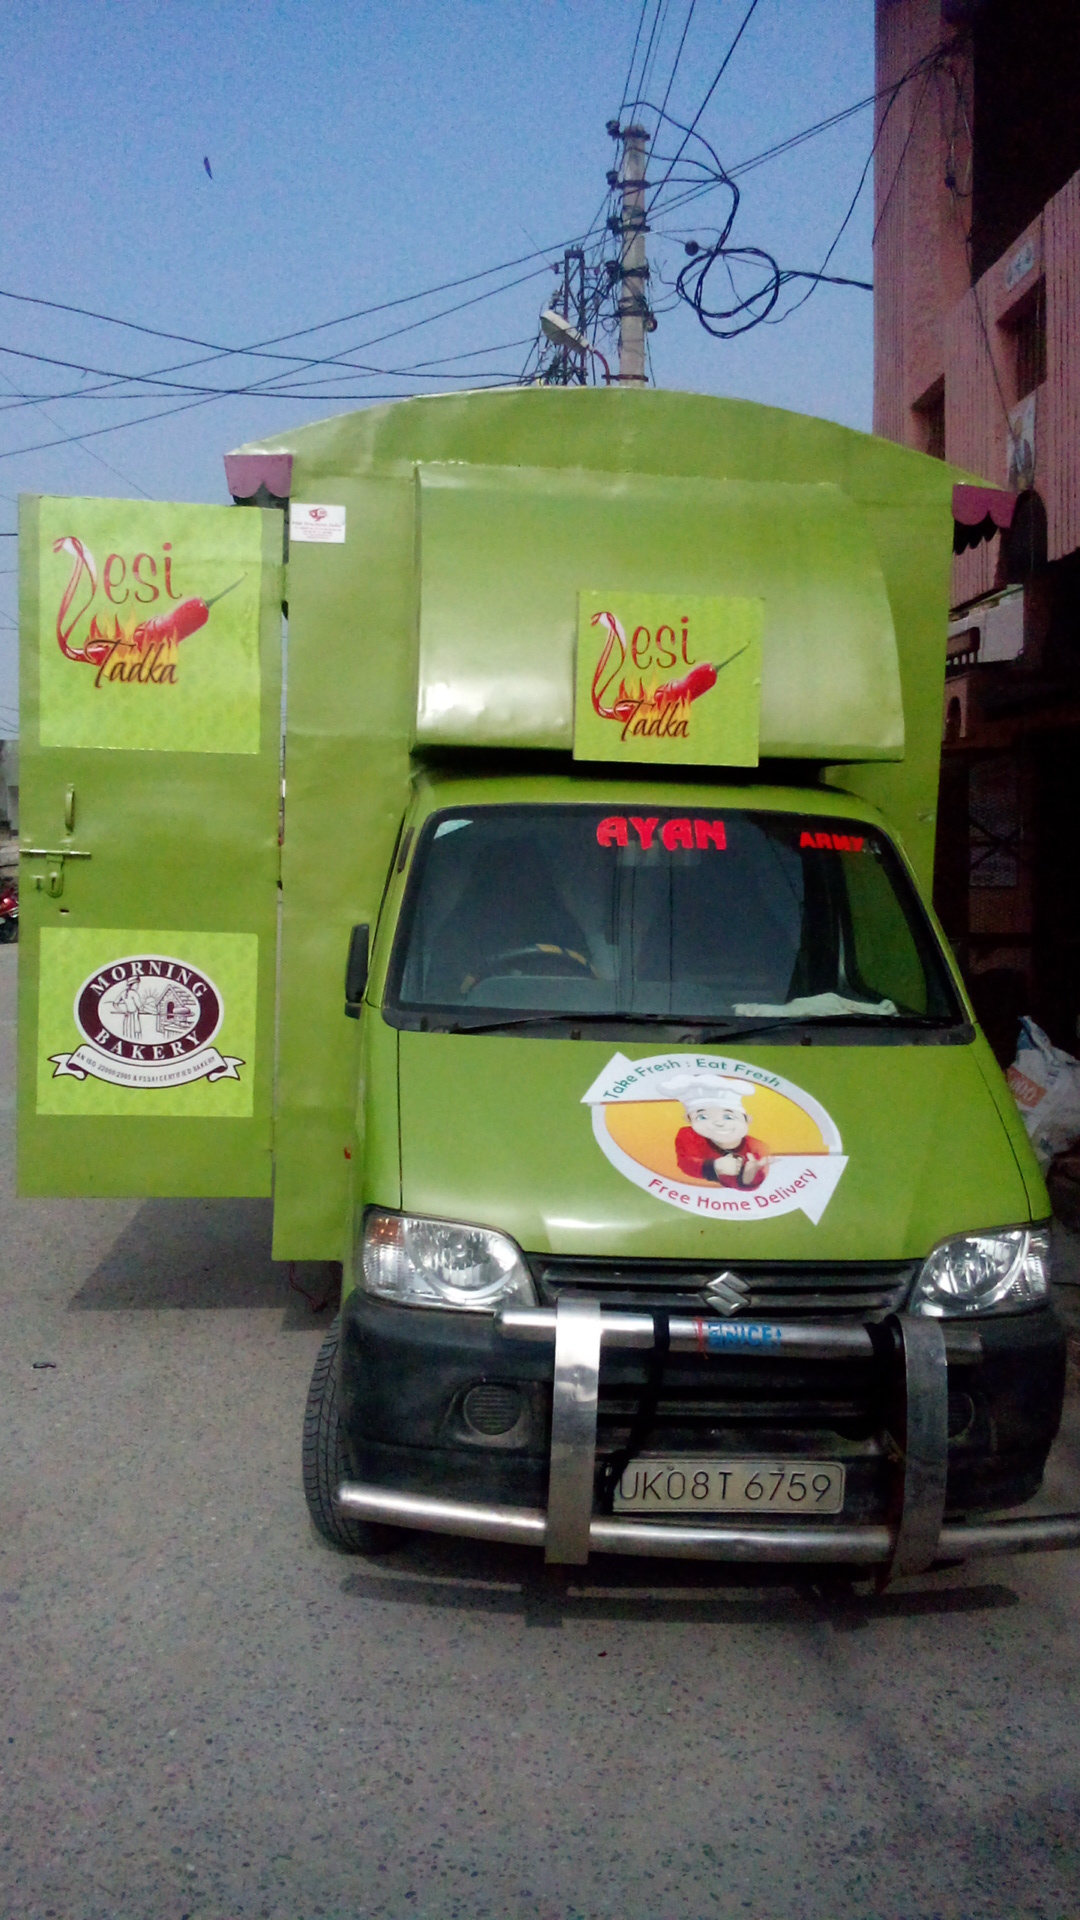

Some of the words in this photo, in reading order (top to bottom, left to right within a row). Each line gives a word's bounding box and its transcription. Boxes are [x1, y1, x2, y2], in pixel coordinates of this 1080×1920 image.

[53, 536, 182, 665] Desi
[84, 638, 178, 688] Tadka
[591, 611, 696, 721] Desi
[613, 699, 689, 742] Tadka
[596, 816, 727, 850] AYAN
[800, 832, 864, 852] ARMY
[89, 961, 208, 997] MORNING
[94, 1028, 201, 1061] BAKERY
[603, 1074, 638, 1099] Take
[635, 1058, 681, 1078] Fresh
[696, 1058, 727, 1071] Eat
[734, 1063, 781, 1088] Fresh
[648, 1178, 692, 1205] Free
[697, 1195, 752, 1211] Home
[754, 1167, 818, 1208] Delivery
